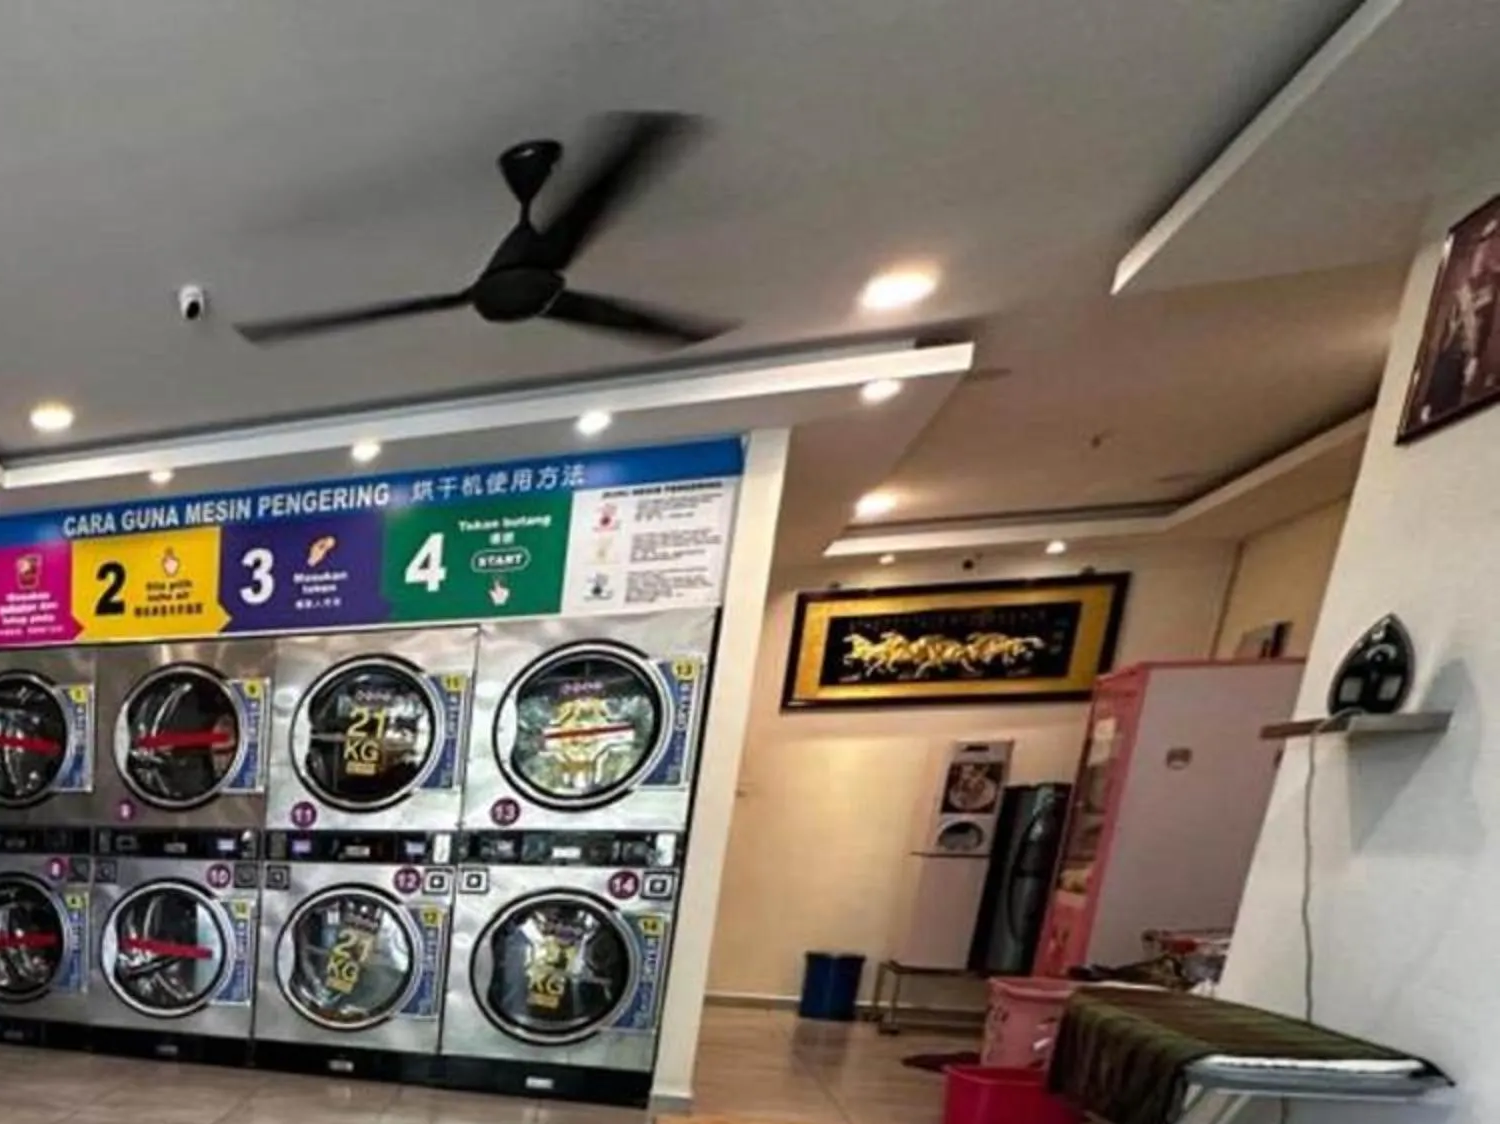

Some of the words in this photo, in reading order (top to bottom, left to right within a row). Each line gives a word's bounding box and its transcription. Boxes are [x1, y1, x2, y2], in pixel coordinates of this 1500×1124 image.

[63, 512, 116, 538] CARA
[121, 505, 179, 531] GUNA
[185, 496, 251, 524] MESIN
[258, 482, 390, 518] PENGERING
[411, 464, 586, 503] 烘干机使用方法
[240, 548, 275, 604] 3
[405, 532, 447, 592] 4
[478, 554, 523, 567] START
[95, 561, 126, 617] 2
[344, 740, 378, 760] KG
[614, 877, 635, 893] 14
